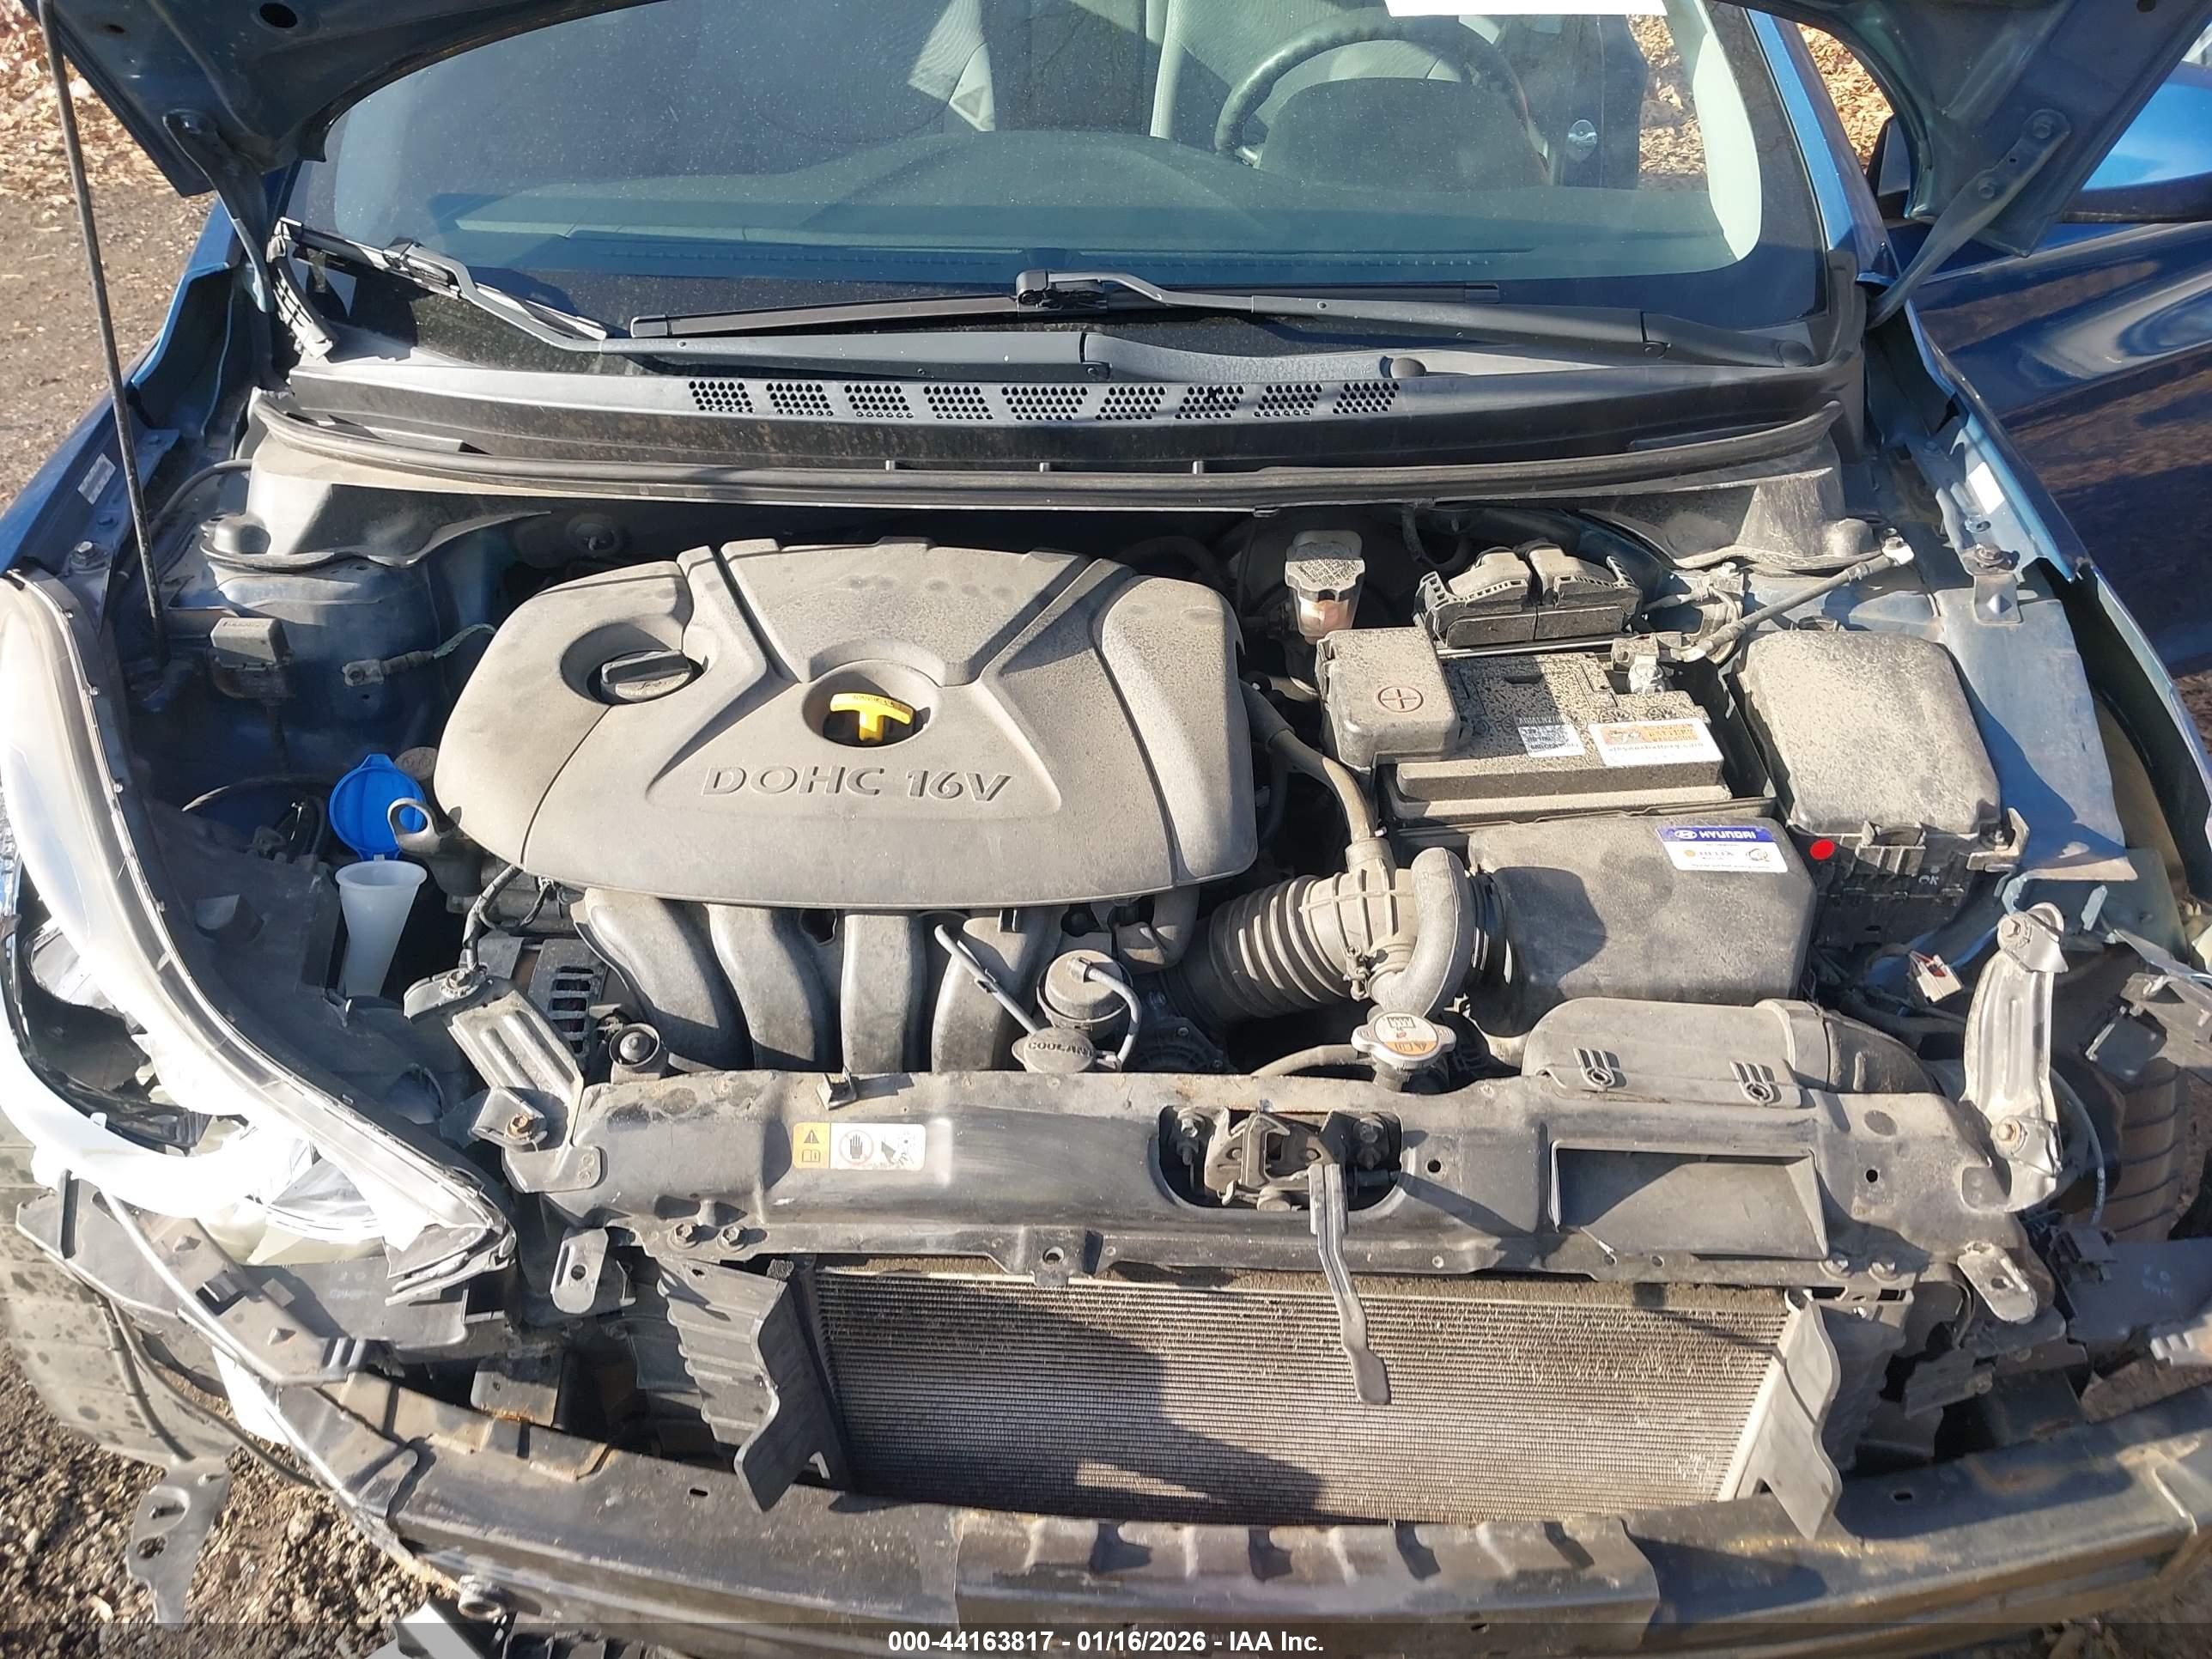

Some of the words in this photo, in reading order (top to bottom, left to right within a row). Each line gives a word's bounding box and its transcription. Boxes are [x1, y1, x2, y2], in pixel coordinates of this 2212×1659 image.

[701, 765, 885, 796] DOHC
[906, 769, 1012, 802] 16V
[1698, 830, 1757, 839] HYUNDAI
